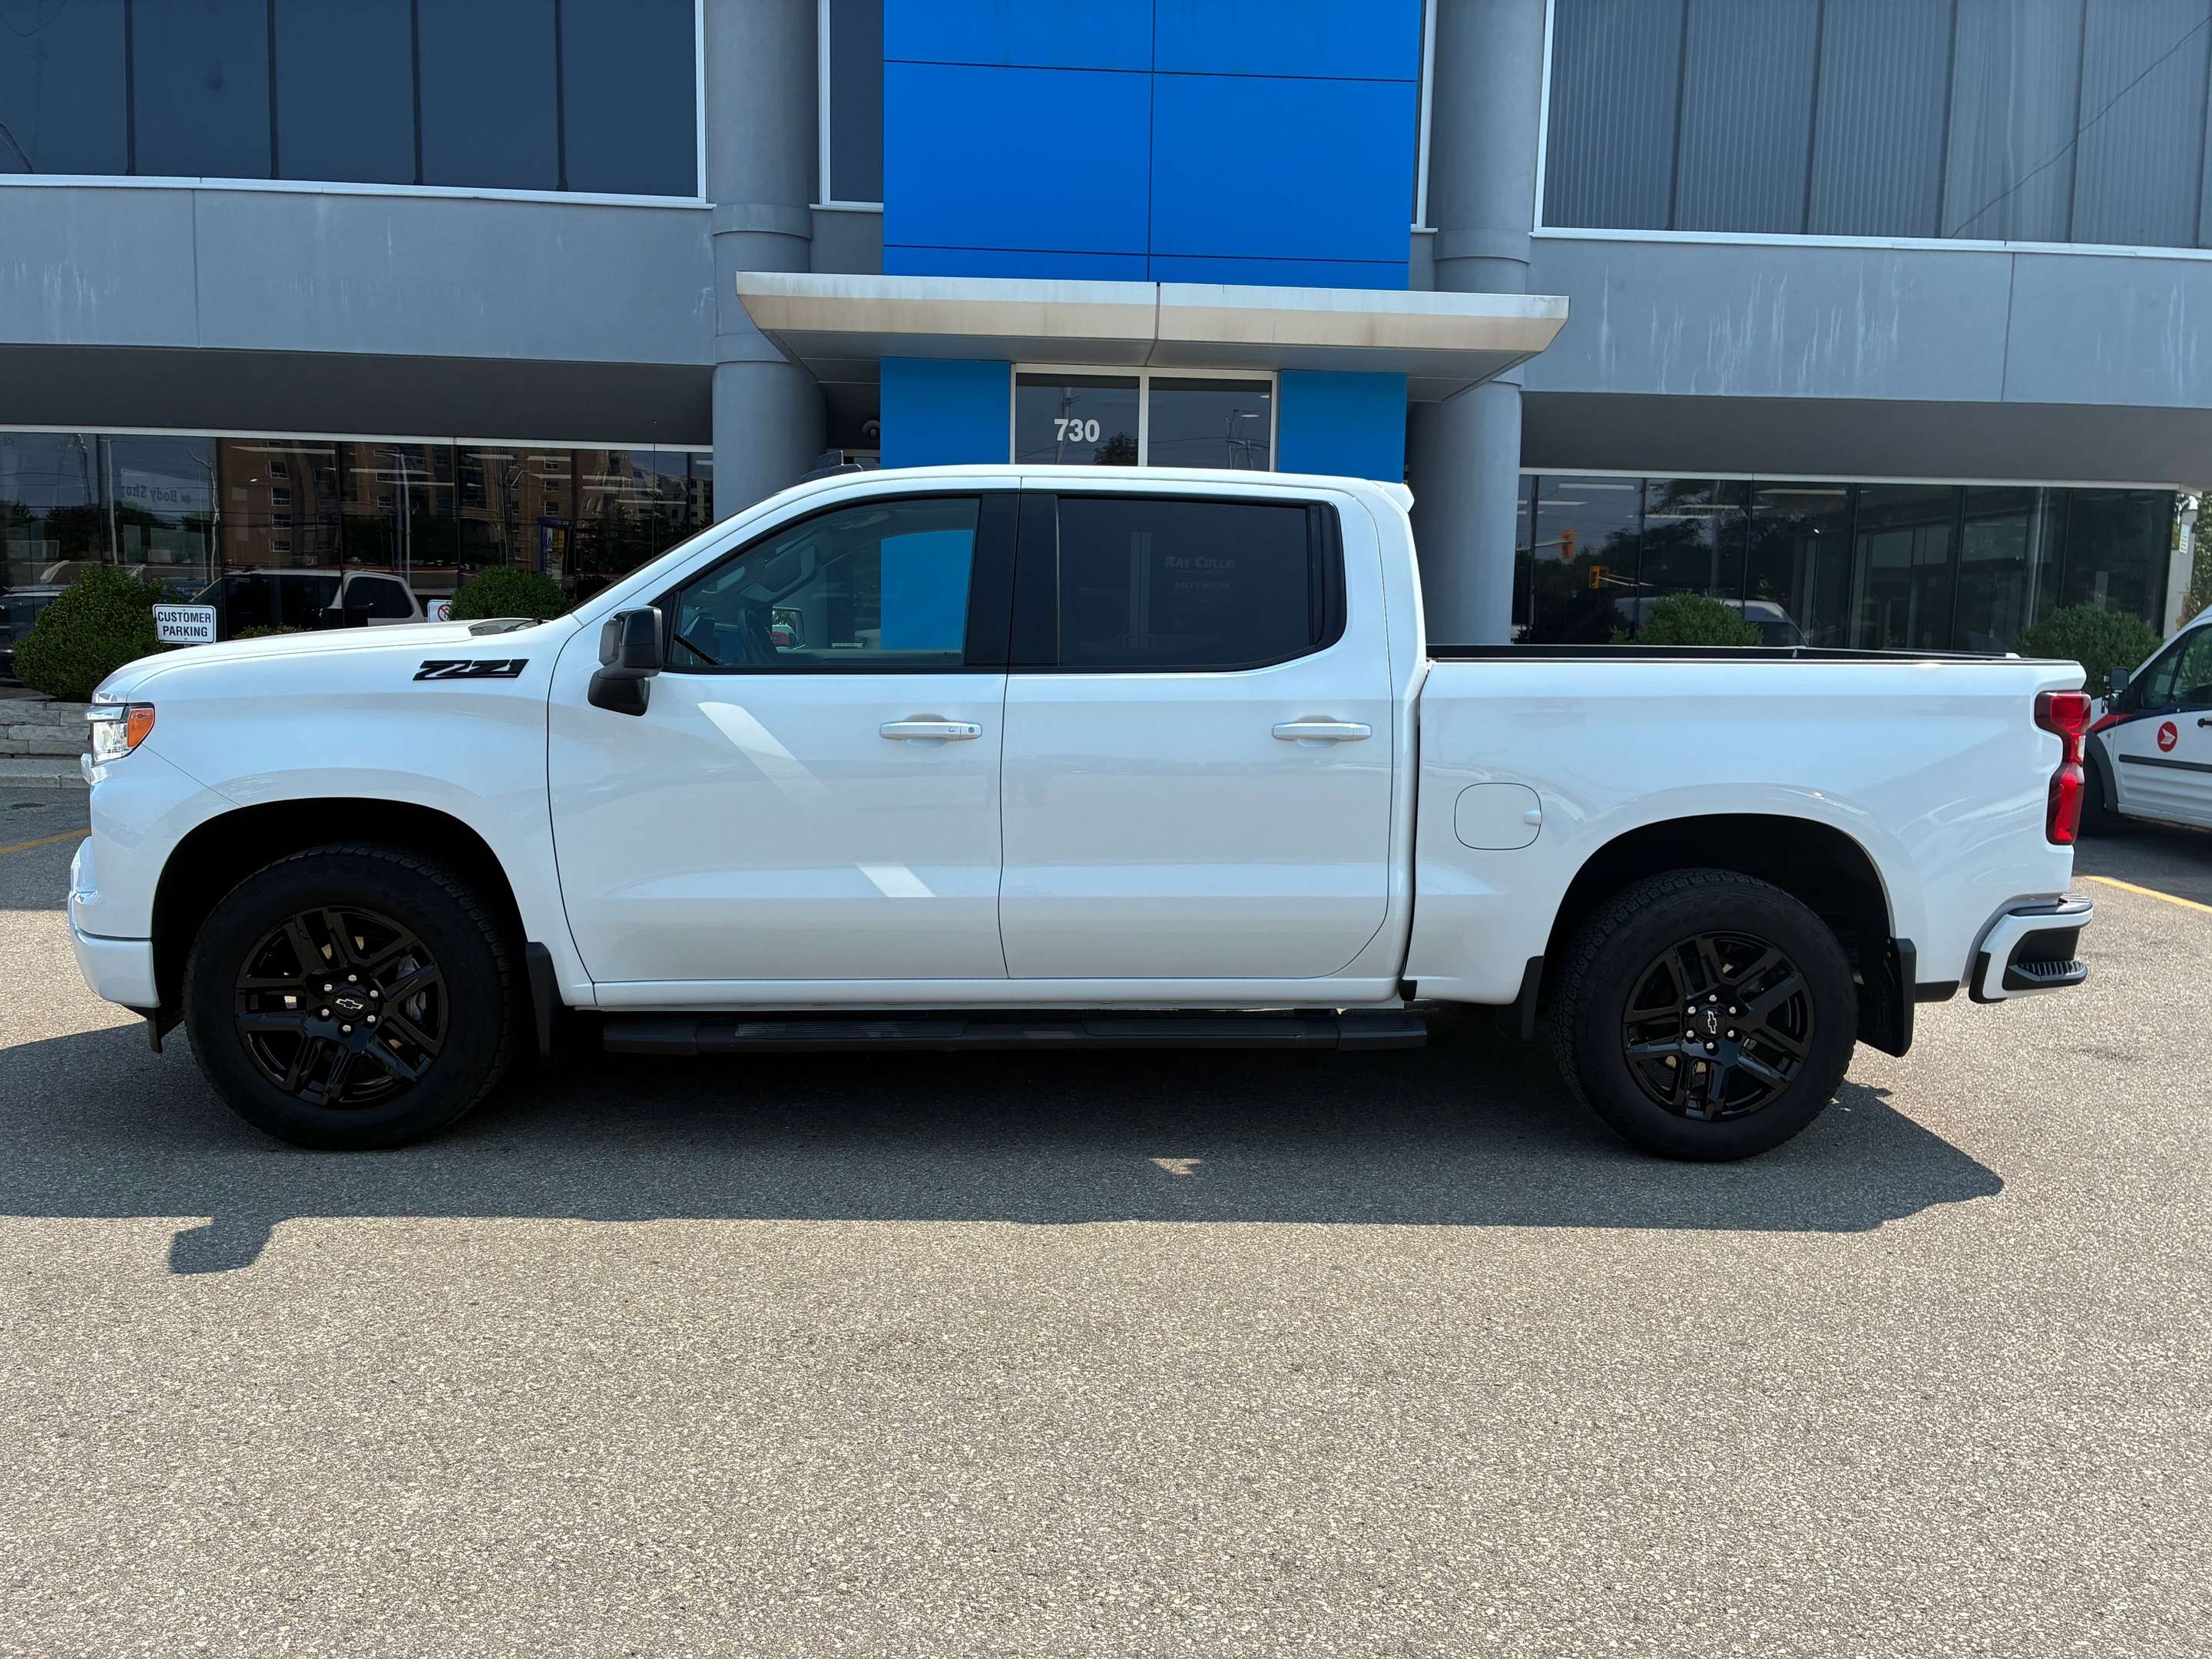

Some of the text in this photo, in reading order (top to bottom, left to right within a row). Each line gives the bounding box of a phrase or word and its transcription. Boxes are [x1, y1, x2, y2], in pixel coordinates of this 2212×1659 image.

[1054, 419, 1100, 442] 730
[157, 611, 211, 623] CUSTOMER
[163, 626, 208, 637] PARKING
[412, 658, 530, 680] Z71
